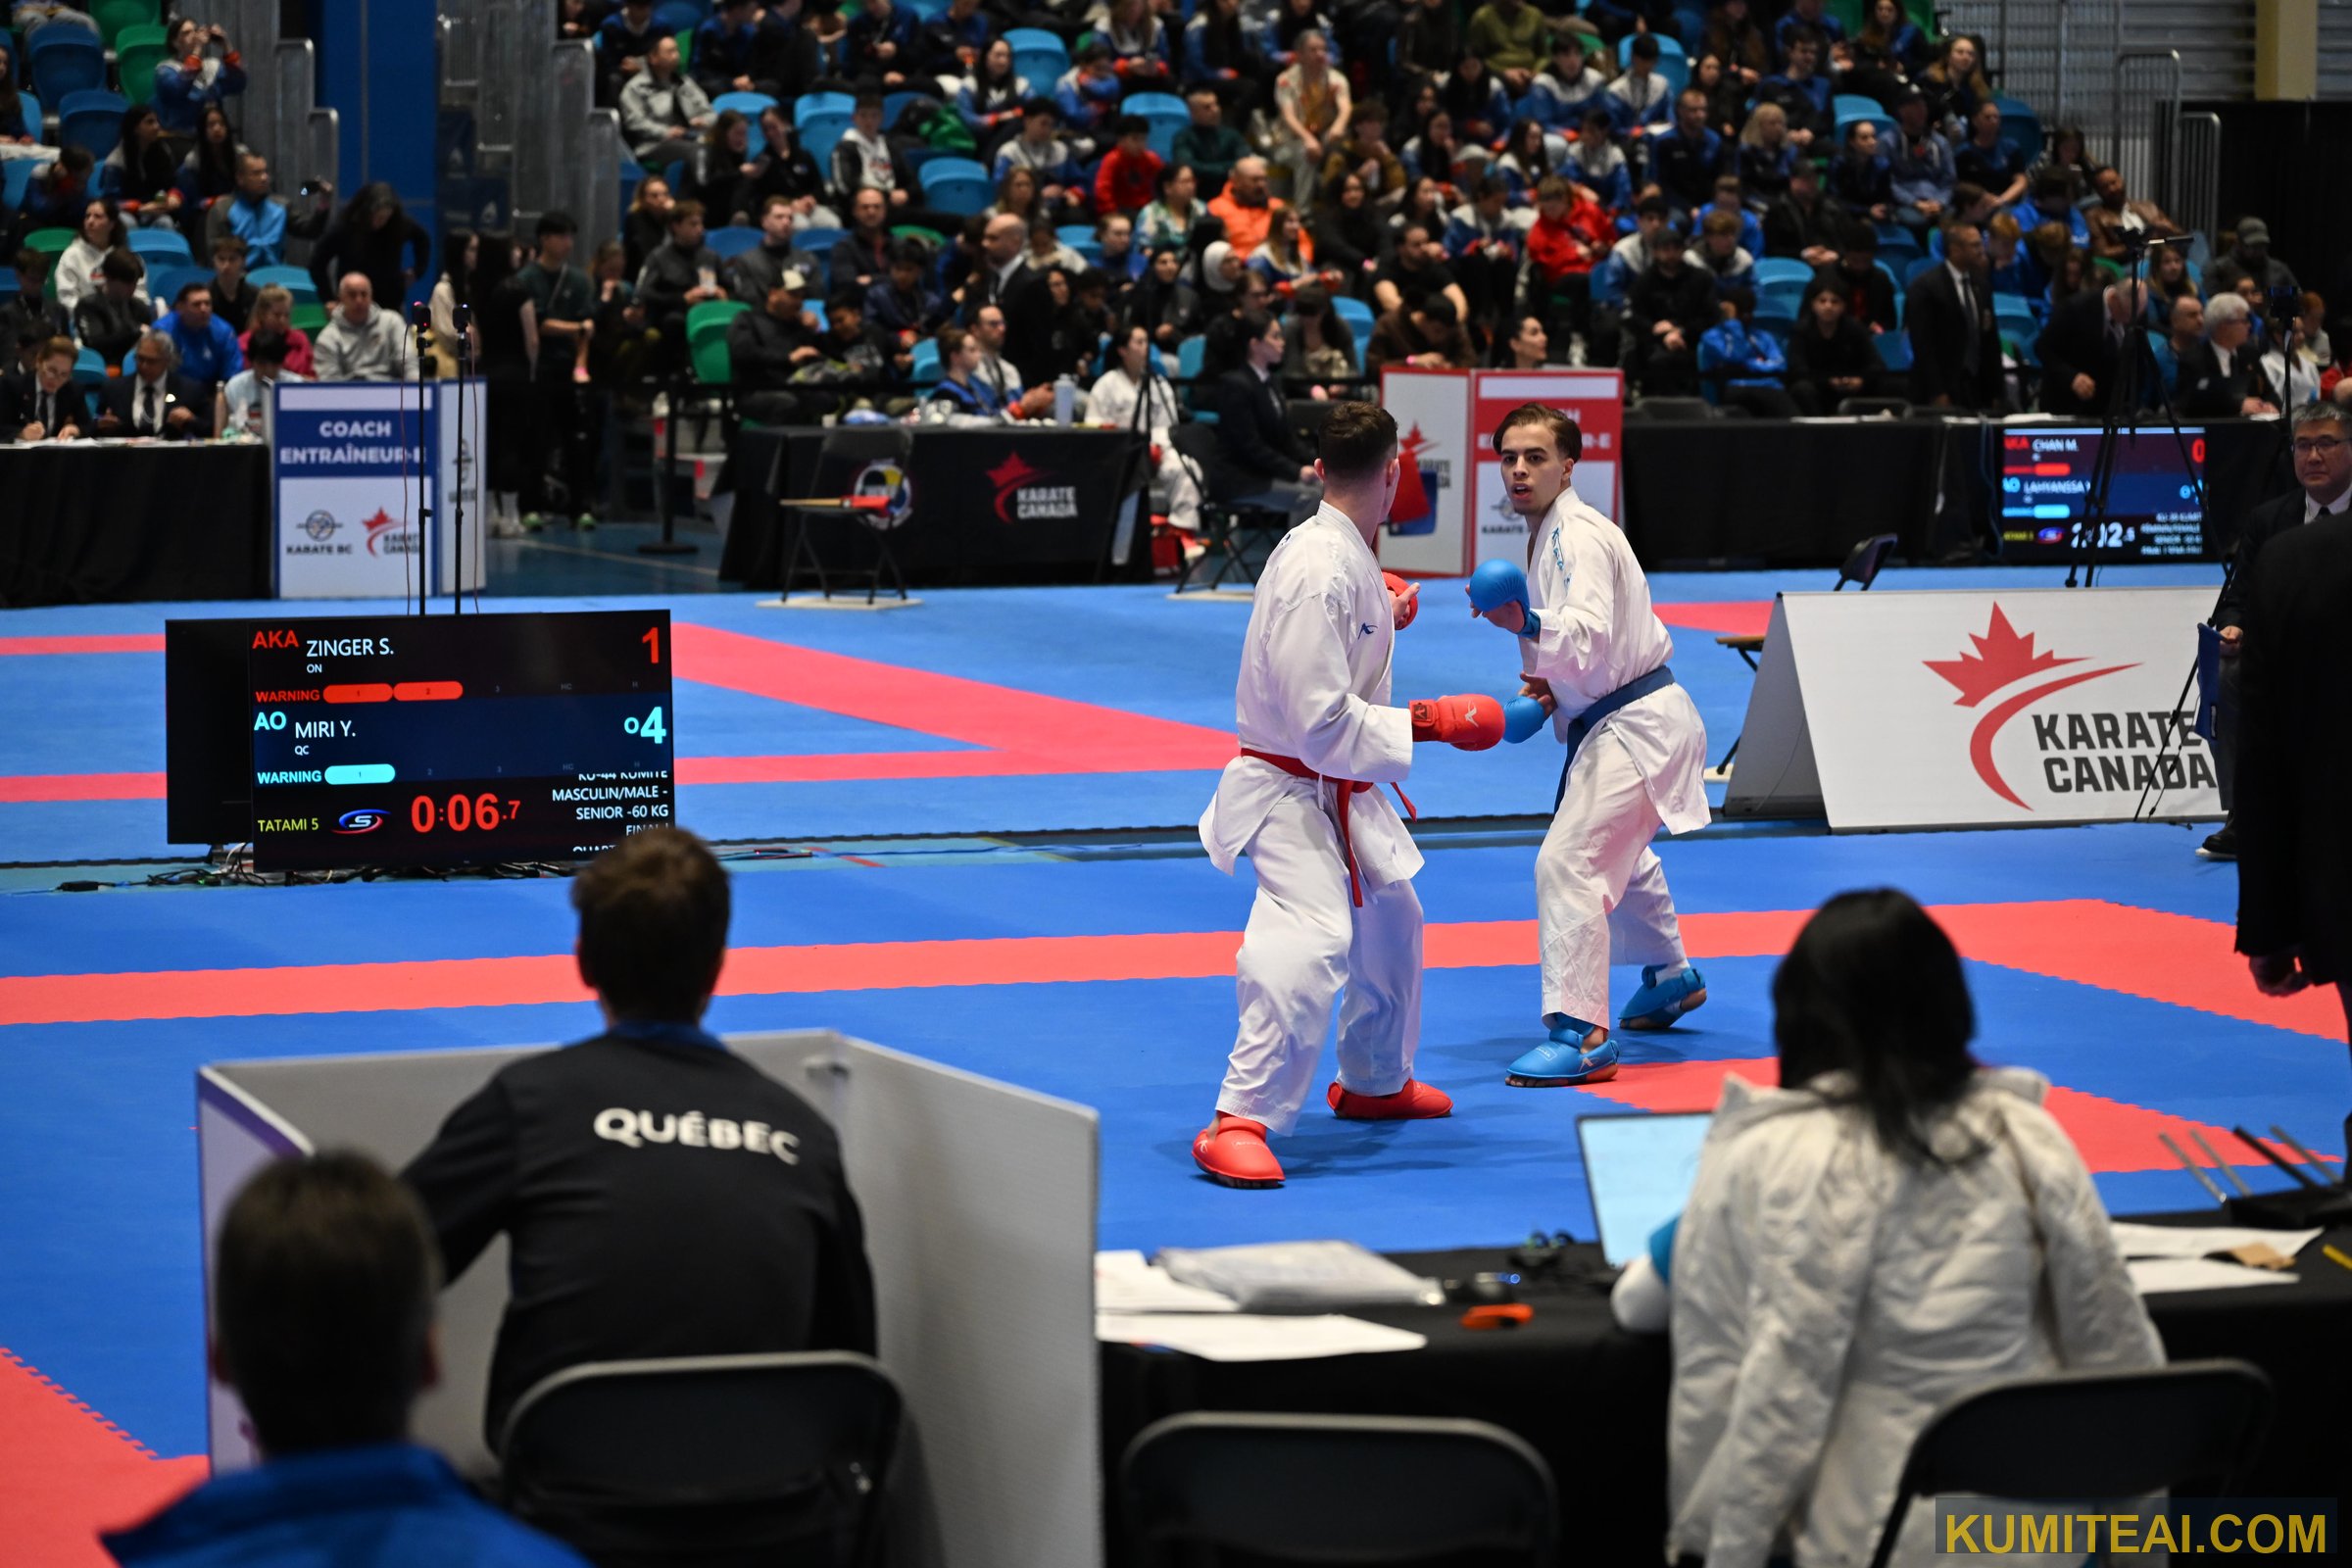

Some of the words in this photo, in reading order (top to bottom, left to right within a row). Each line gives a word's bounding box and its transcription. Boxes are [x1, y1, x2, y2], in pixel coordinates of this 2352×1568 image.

[319, 420, 392, 437] COACH
[1017, 486, 1076, 502] KARATE
[1017, 503, 1078, 519] CANADA
[252, 630, 299, 649] AKA
[306, 639, 374, 657] ZINGER
[379, 638, 394, 656] S.
[642, 627, 660, 663] 1
[307, 663, 322, 673] ON
[256, 689, 320, 703] WARNING
[254, 710, 287, 731] AO
[295, 720, 334, 738] MIRI
[340, 719, 356, 737] Y.
[2032, 710, 2203, 751] KARATE
[294, 745, 309, 756] QC
[257, 770, 322, 784] WARNING
[2043, 753, 2217, 794] CANADA
[552, 785, 660, 802] MASCULIN/MALE
[576, 806, 624, 820] SENIOR
[626, 805, 648, 818] -60
[651, 804, 669, 817] KG
[258, 818, 308, 833] TATAMI
[312, 817, 318, 830] 5
[593, 1106, 801, 1165] QUÉBEC
